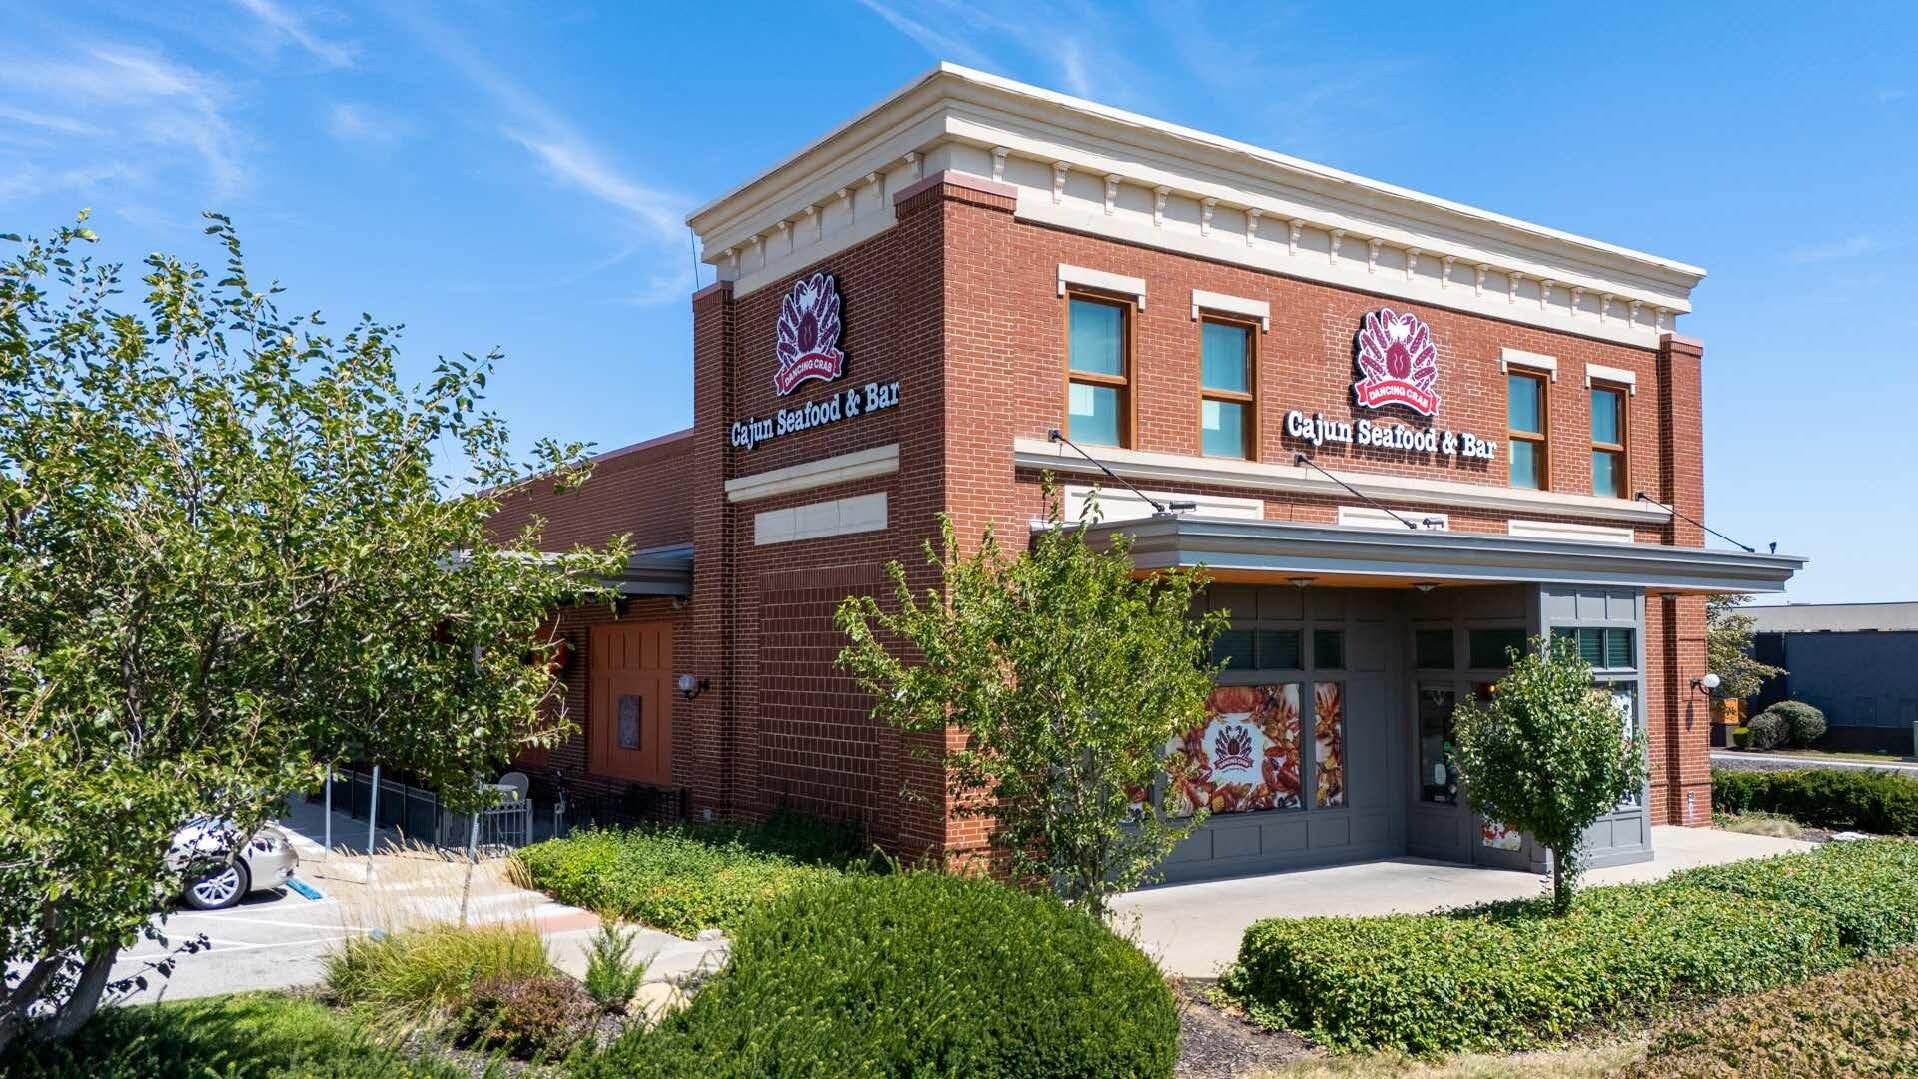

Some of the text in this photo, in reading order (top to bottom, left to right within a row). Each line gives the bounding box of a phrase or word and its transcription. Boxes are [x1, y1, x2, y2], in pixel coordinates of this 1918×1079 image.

[784, 358, 832, 387] DANCING CRAB
[731, 382, 900, 449] Cajun Seafood & Bar
[1369, 385, 1429, 407] DANCING CRAB
[1287, 410, 1498, 459] Cajun Seafood & Bar
